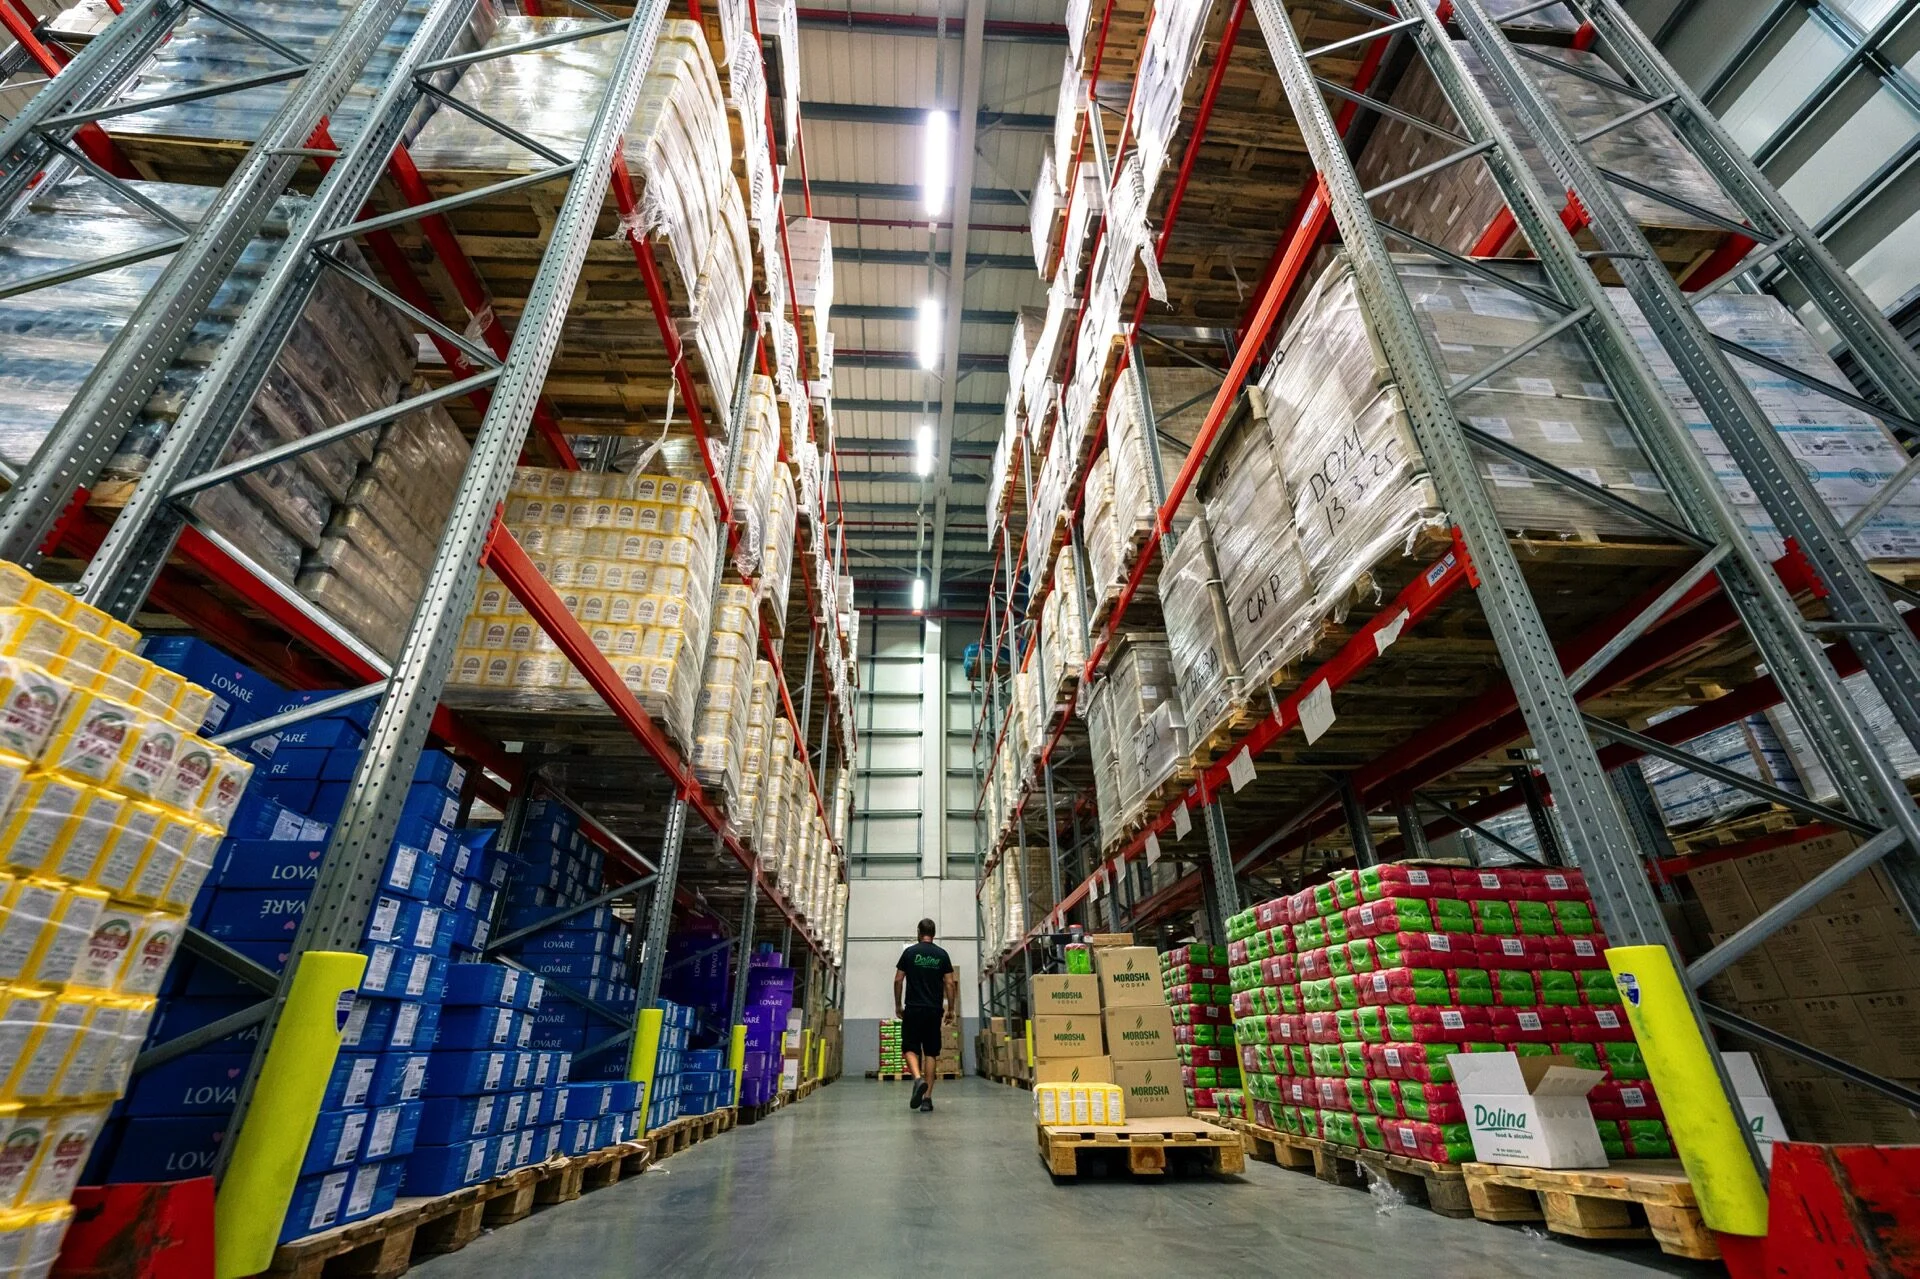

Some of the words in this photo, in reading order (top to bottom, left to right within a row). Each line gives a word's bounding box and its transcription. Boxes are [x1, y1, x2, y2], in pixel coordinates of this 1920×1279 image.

[211, 673, 254, 703] LOVARÉ
[271, 865, 318, 879] LOVA
[260, 900, 306, 918] VARÉ
[543, 939, 575, 948] LOVARÉ
[540, 964, 572, 973] LOVARÉ
[1113, 972, 1150, 982] MOROSHA
[1051, 991, 1083, 999] MOROSHA
[1054, 1033, 1086, 1041] MOROSHA
[1122, 1030, 1160, 1040] MOROSHA
[183, 1086, 238, 1104] LOVA
[1131, 1085, 1169, 1096] MOROSHA
[1474, 1104, 1526, 1128] Dolina
